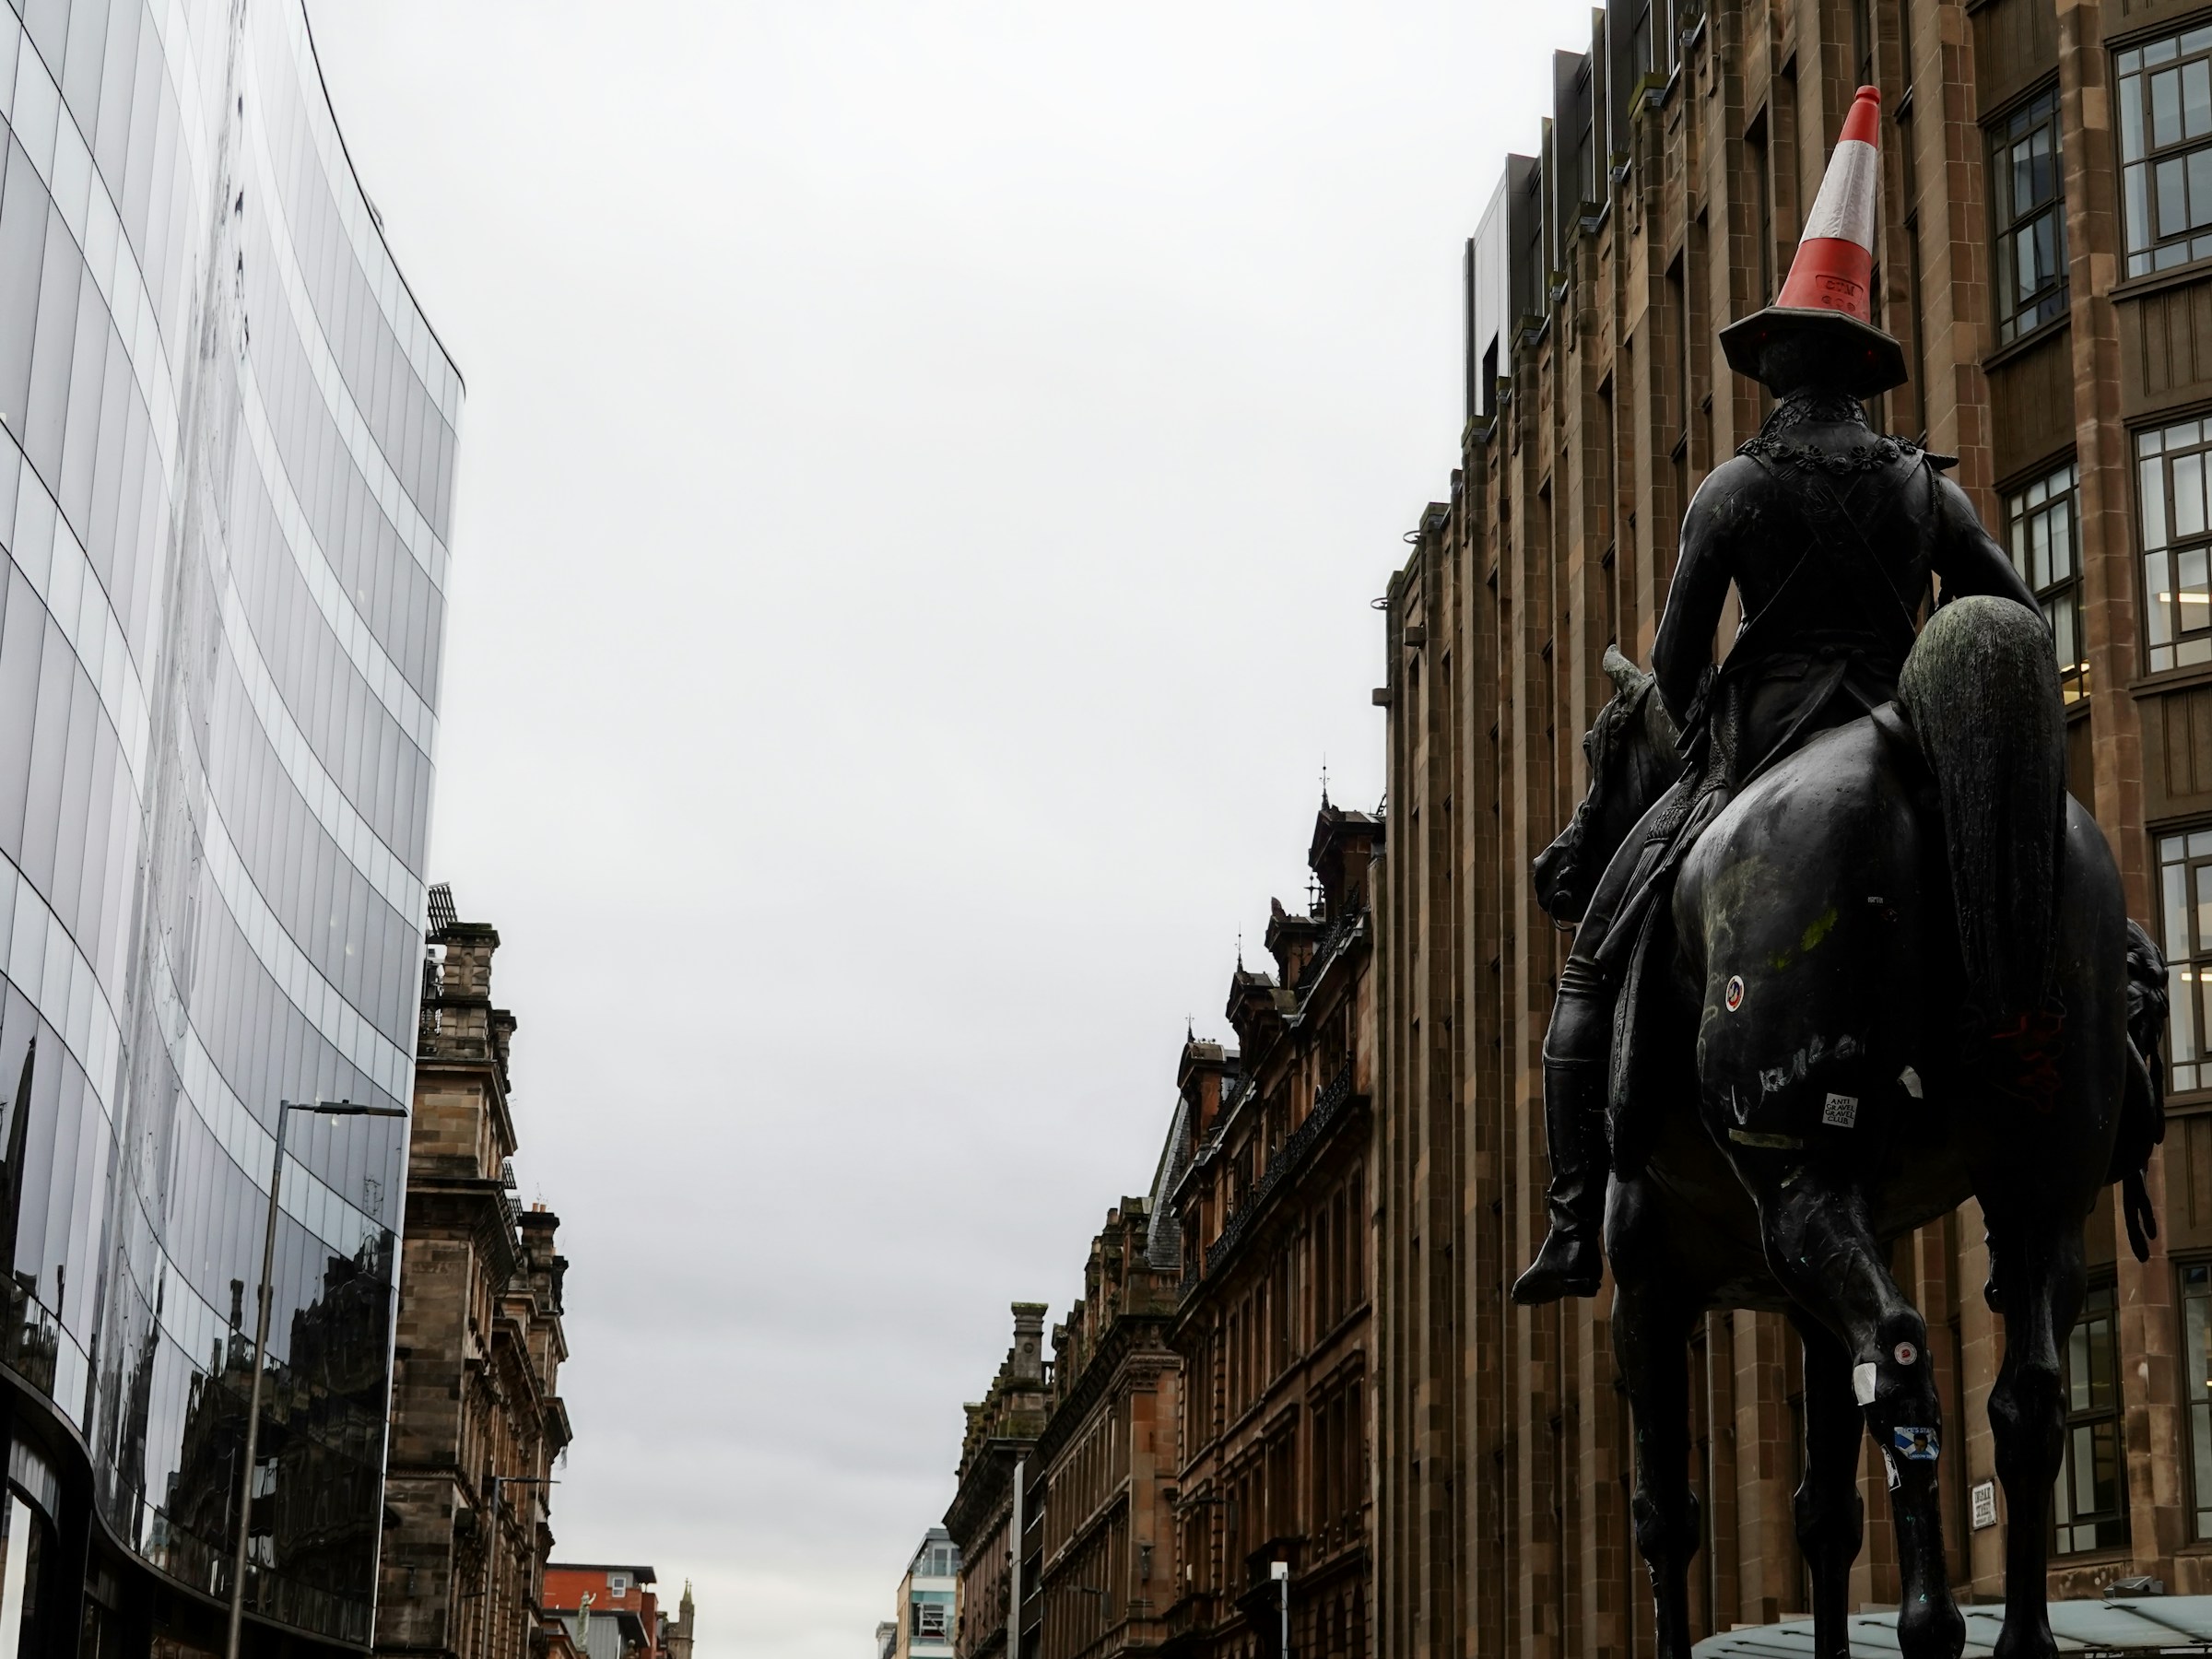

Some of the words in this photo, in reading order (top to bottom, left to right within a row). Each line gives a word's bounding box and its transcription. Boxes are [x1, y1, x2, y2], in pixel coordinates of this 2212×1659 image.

[1826, 1103, 1854, 1112] GRAVEL
[1825, 1110, 1854, 1119] GRAVEL
[1828, 1116, 1849, 1124] CLUB
